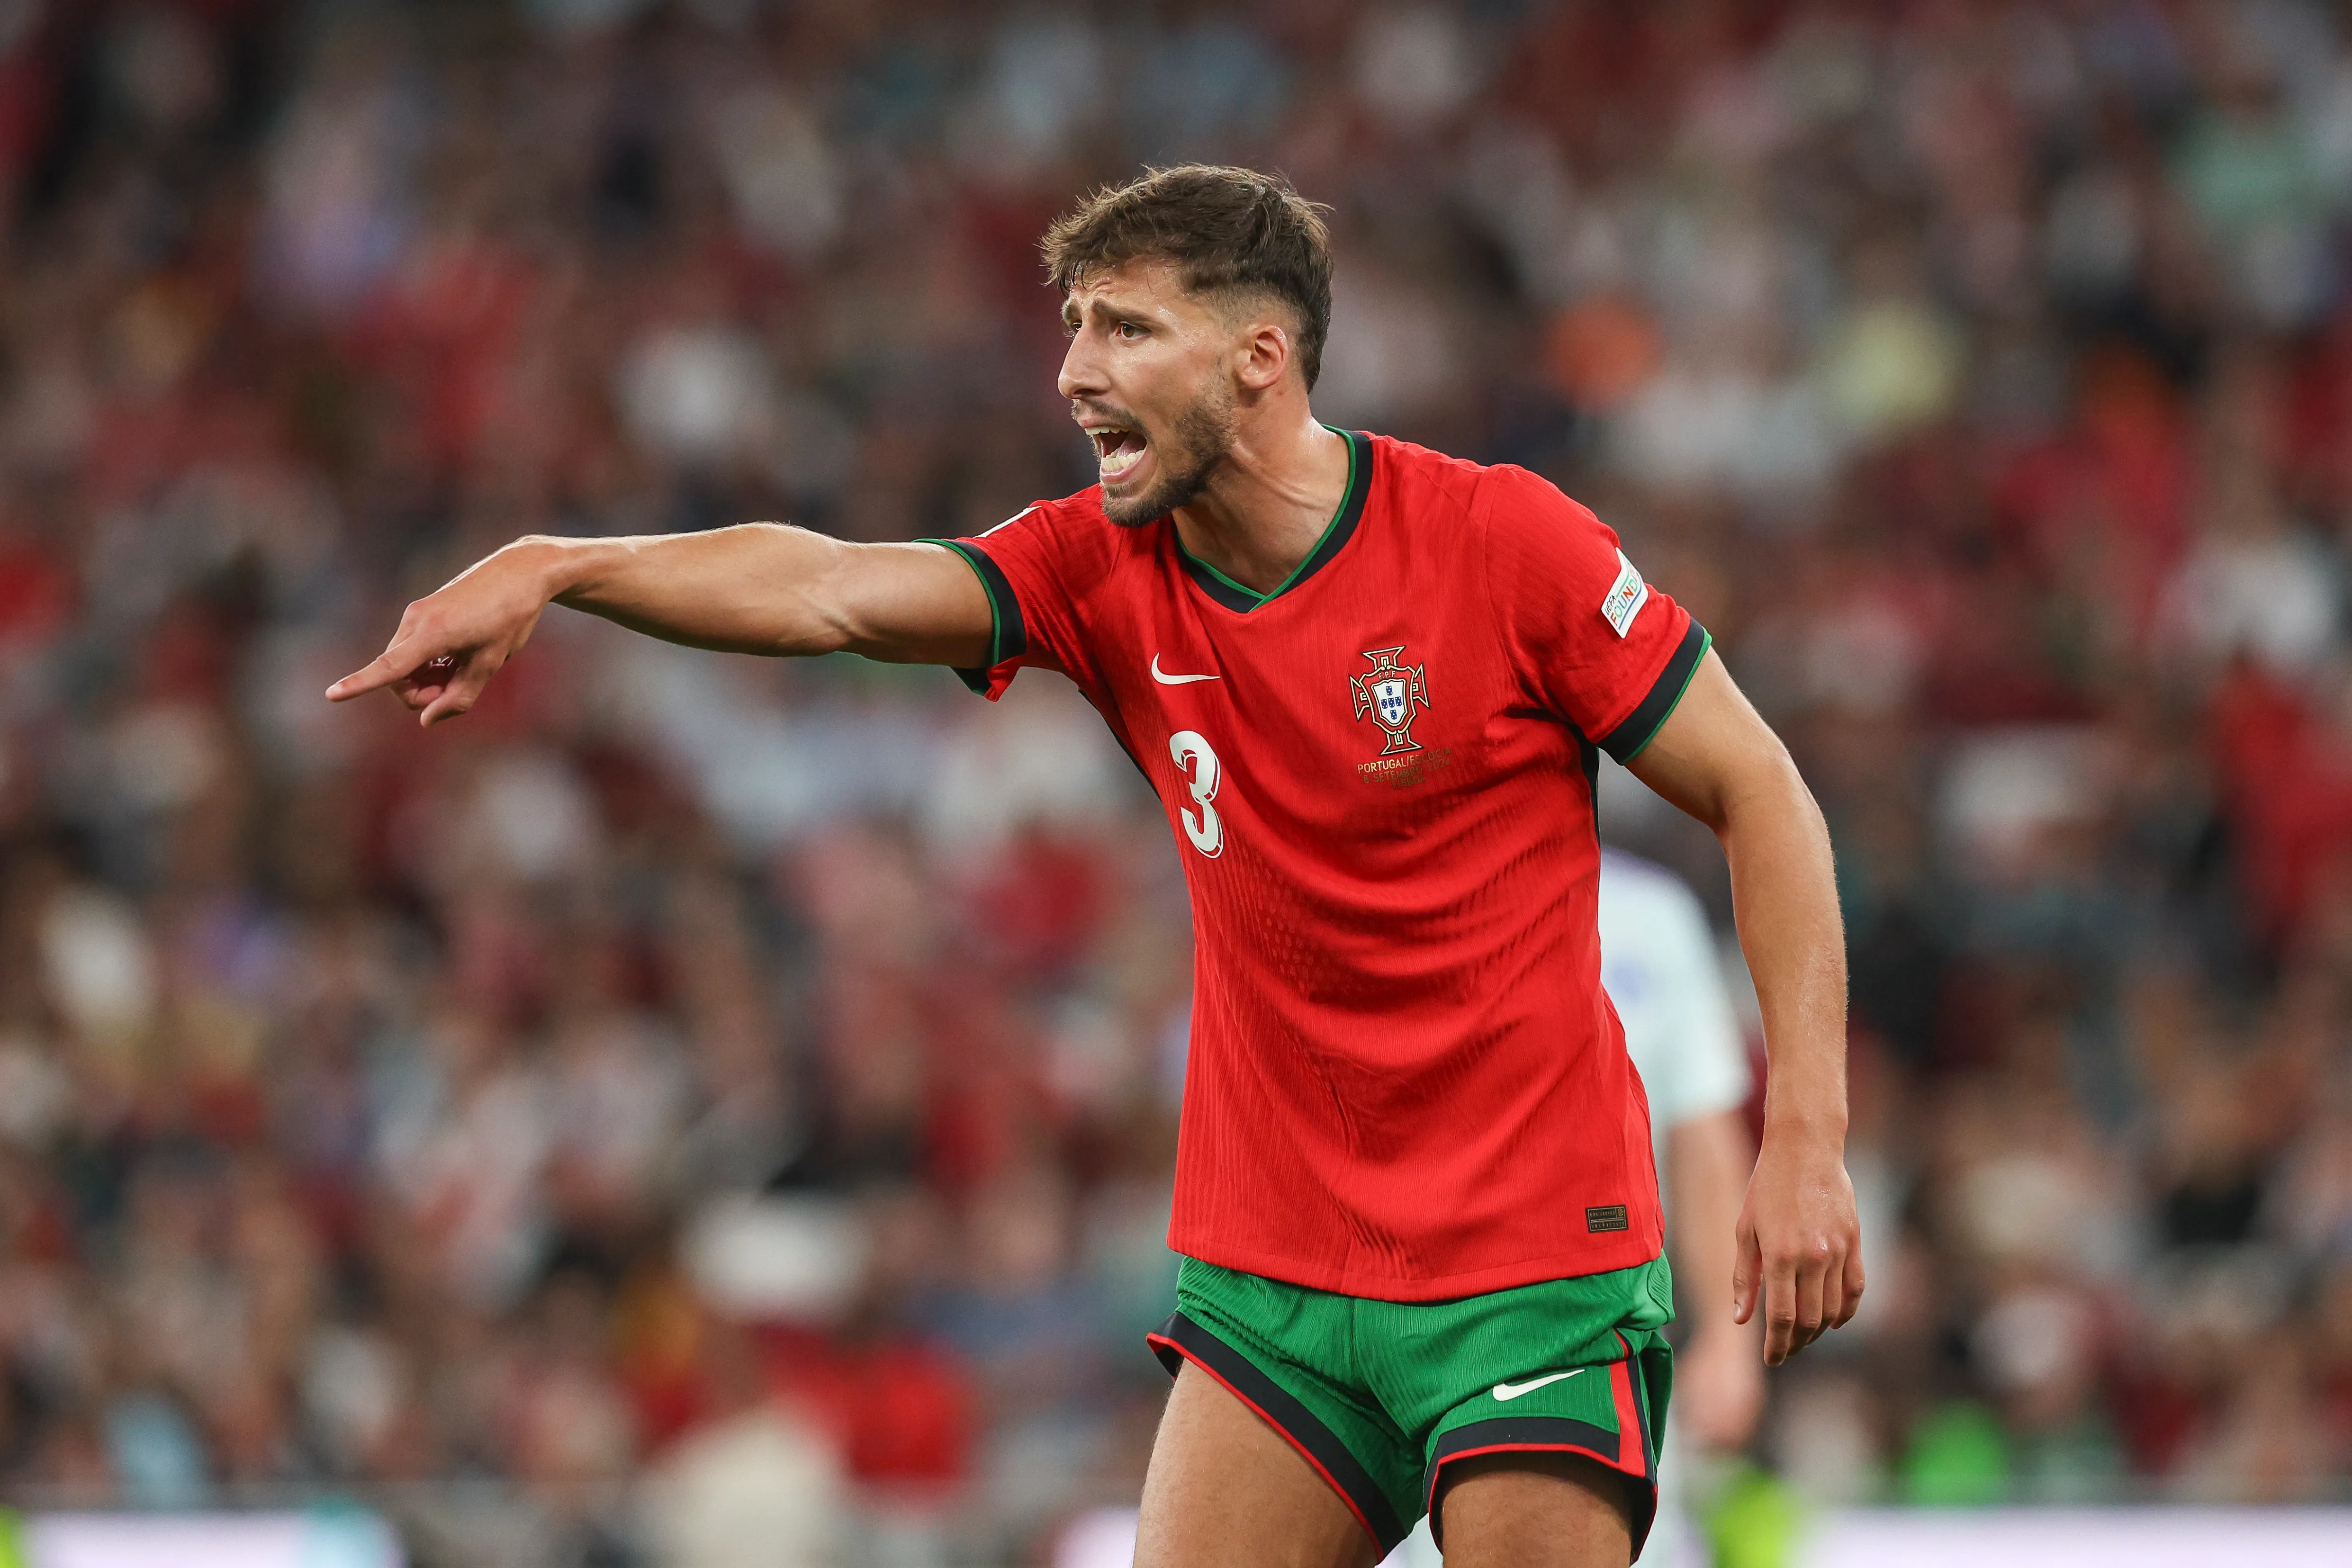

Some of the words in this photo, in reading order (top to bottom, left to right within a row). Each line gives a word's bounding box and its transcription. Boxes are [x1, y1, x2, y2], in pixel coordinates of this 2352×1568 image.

[1604, 595, 1616, 615] UEFA
[1379, 670, 1397, 679] F.P.F.
[1169, 730, 1224, 858] 3
